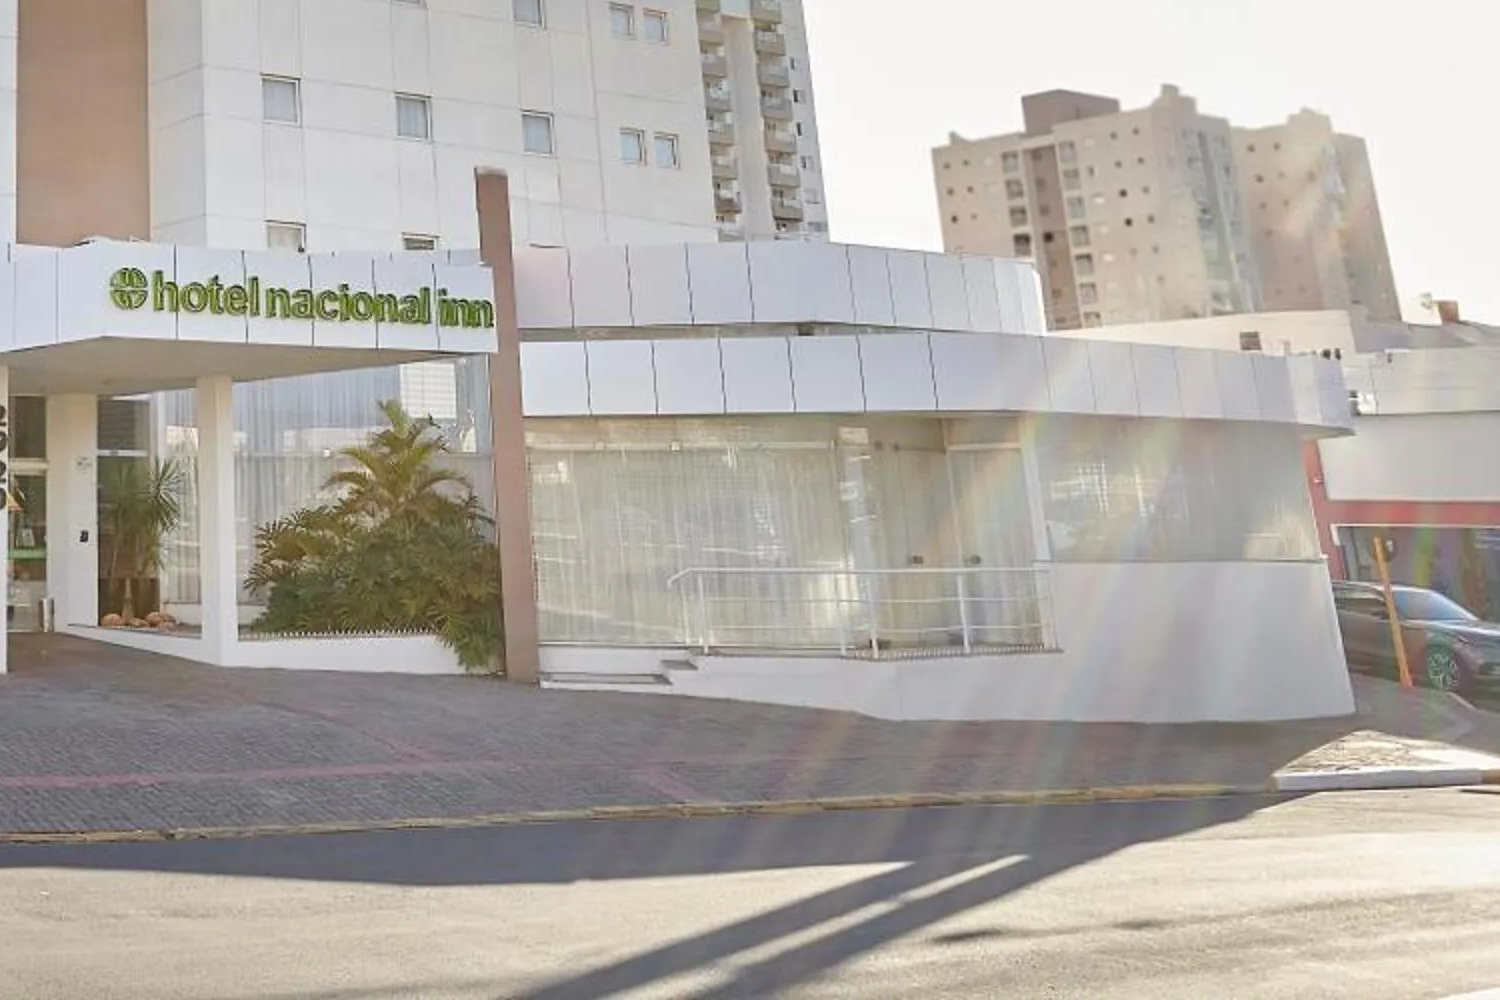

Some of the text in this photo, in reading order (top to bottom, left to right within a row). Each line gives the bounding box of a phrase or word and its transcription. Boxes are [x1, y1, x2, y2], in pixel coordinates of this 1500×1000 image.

[152, 269, 495, 329] hotel nacional inn
